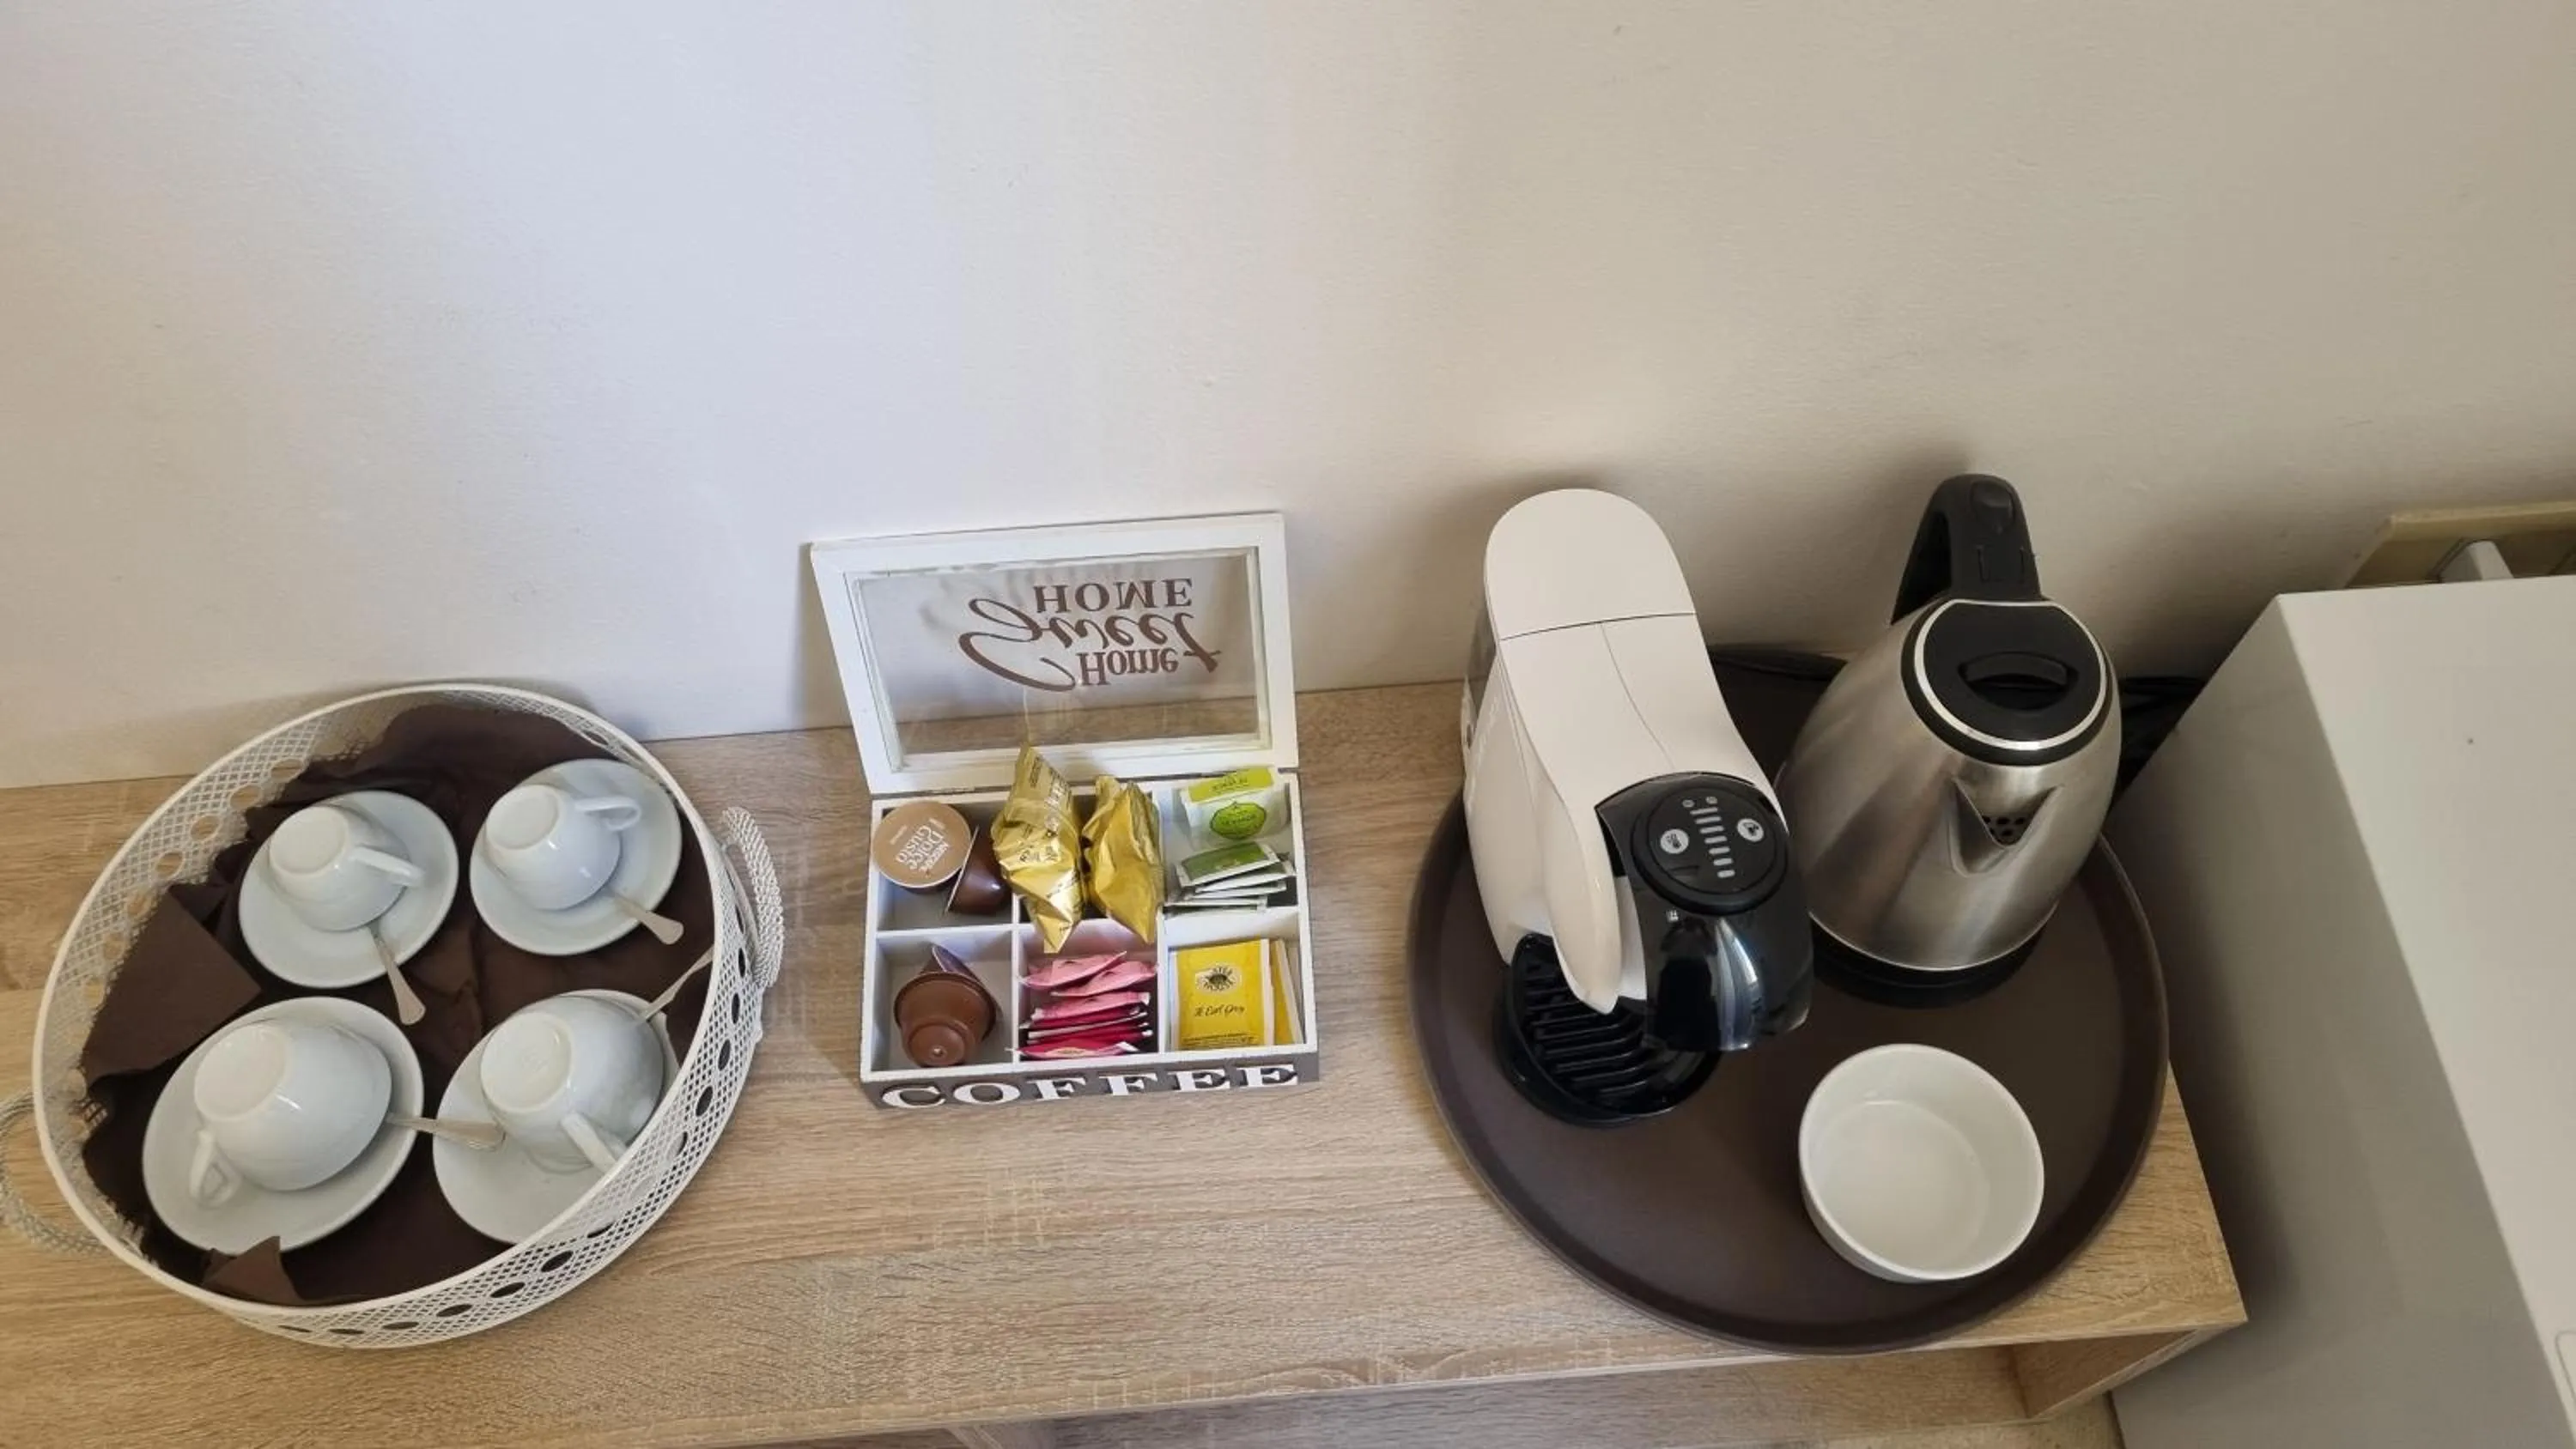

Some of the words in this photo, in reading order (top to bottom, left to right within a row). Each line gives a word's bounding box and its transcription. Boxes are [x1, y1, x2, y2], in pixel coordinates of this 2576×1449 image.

[896, 825, 932, 864] Gusto
[910, 830, 945, 870] Dolce
[881, 1064, 1299, 1108] COFFEE
